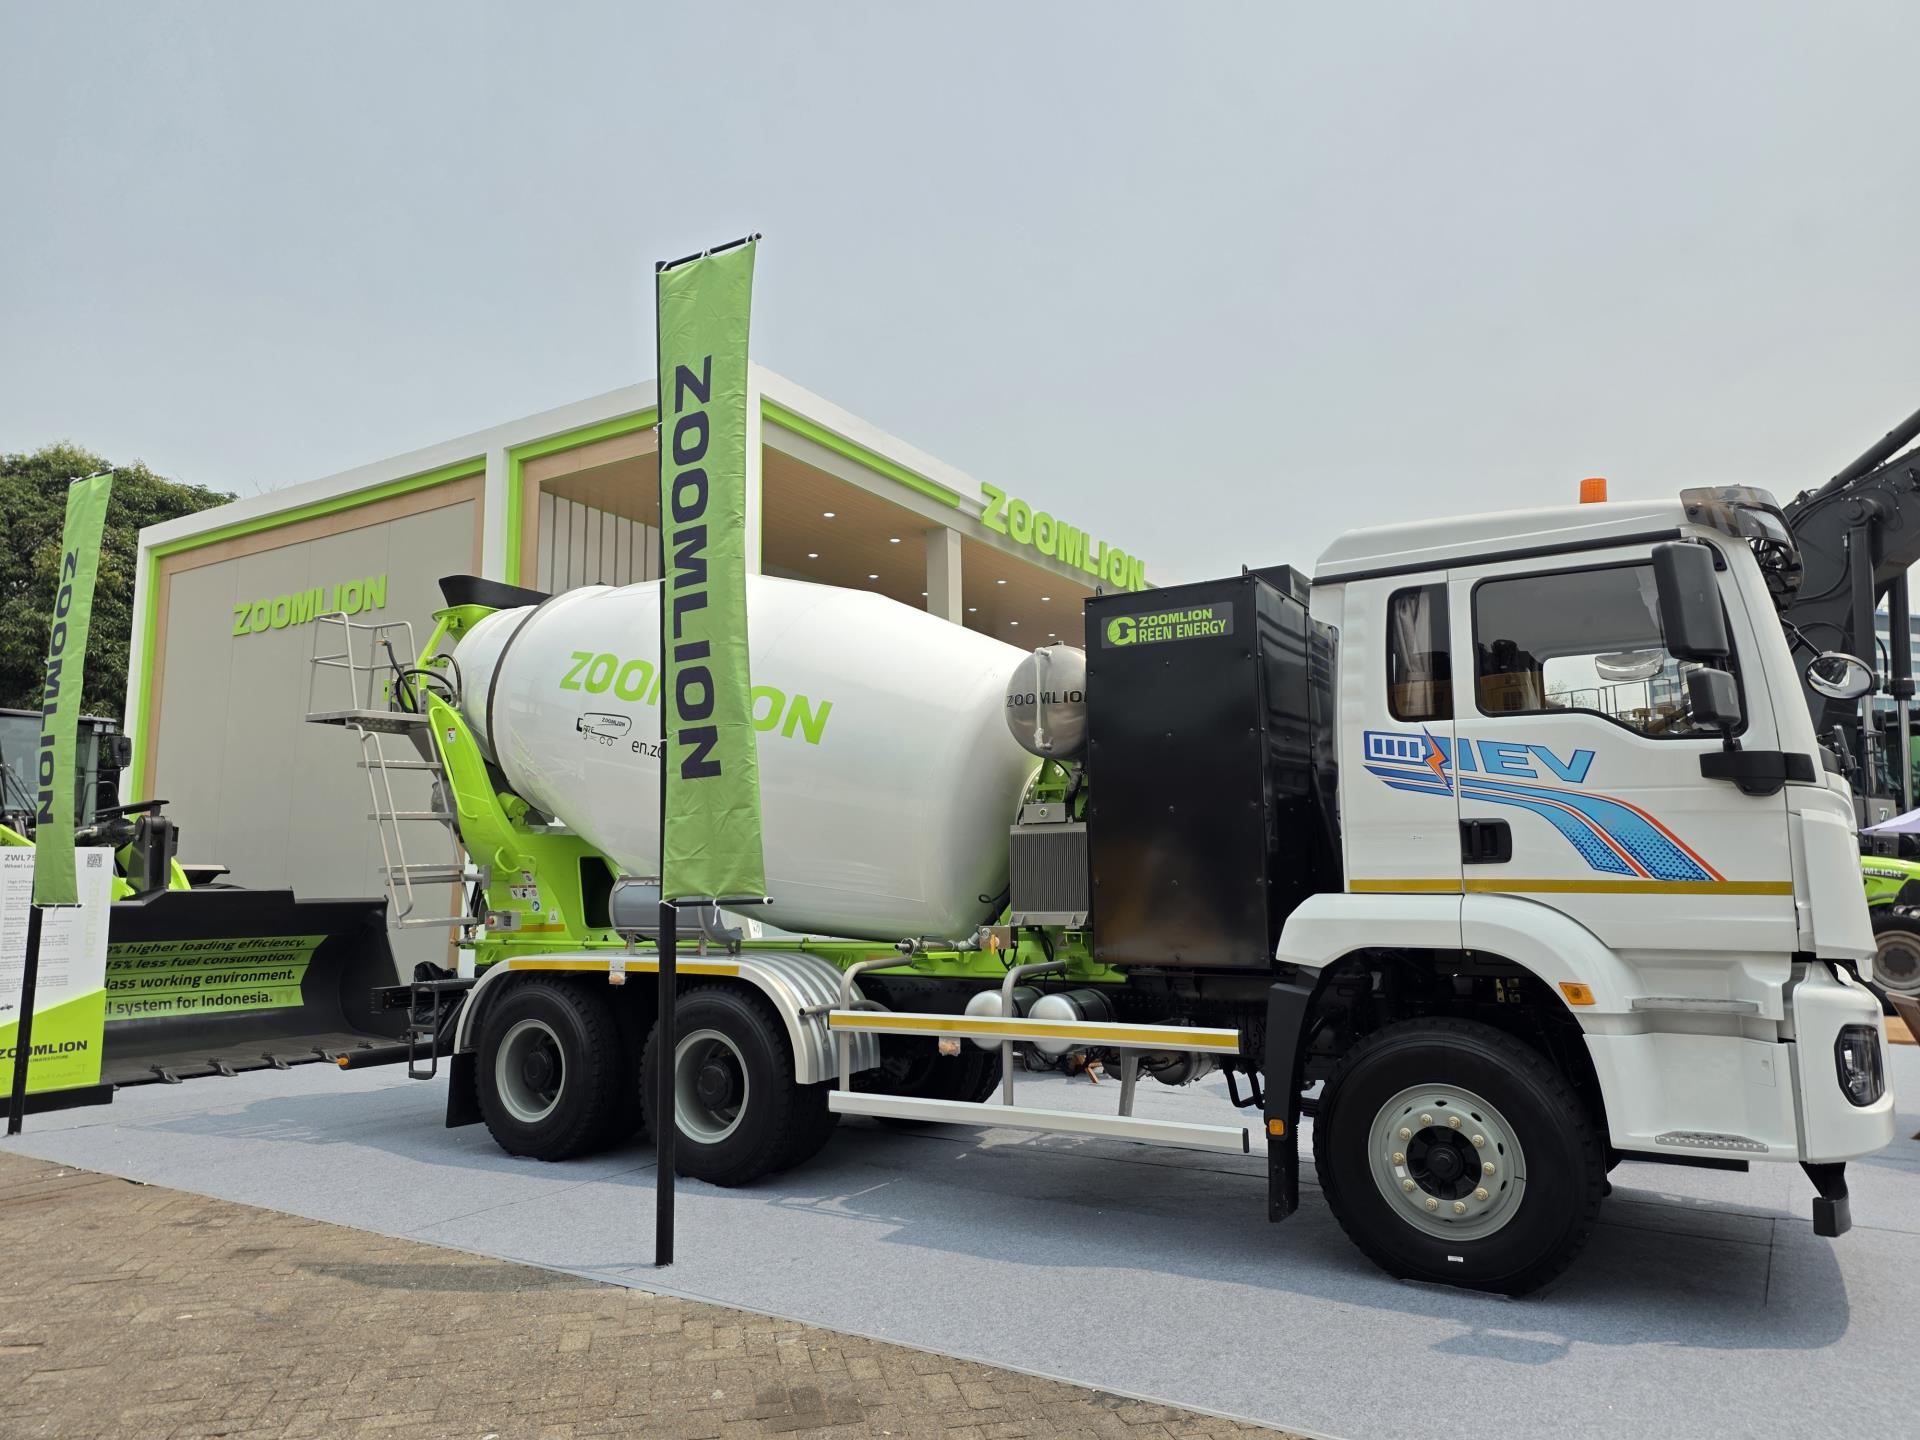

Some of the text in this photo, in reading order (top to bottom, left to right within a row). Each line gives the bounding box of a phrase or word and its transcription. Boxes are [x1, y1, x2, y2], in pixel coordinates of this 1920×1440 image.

[981, 481, 1145, 592] ZOOMLION
[672, 355, 722, 780] ZOOMLION
[232, 574, 388, 636] ZOOMLION
[1140, 608, 1213, 627] ZOOMLION
[1176, 619, 1226, 638] ENERGY
[37, 547, 79, 825] ZOOMLION
[559, 651, 833, 745] ZOOON
[1007, 691, 1088, 707] ZOOMLIO
[1862, 867, 1902, 878] MLION
[127, 943, 178, 955] higher
[180, 941, 236, 951] loading
[238, 938, 305, 950] efficiency.
[136, 959, 169, 969] less
[170, 956, 202, 967] fuel
[203, 953, 296, 965] consumption.
[104, 969, 295, 990] lass working environment.
[117, 999, 172, 1016] system
[176, 997, 198, 1009] for
[202, 991, 273, 1007] Indonesia.
